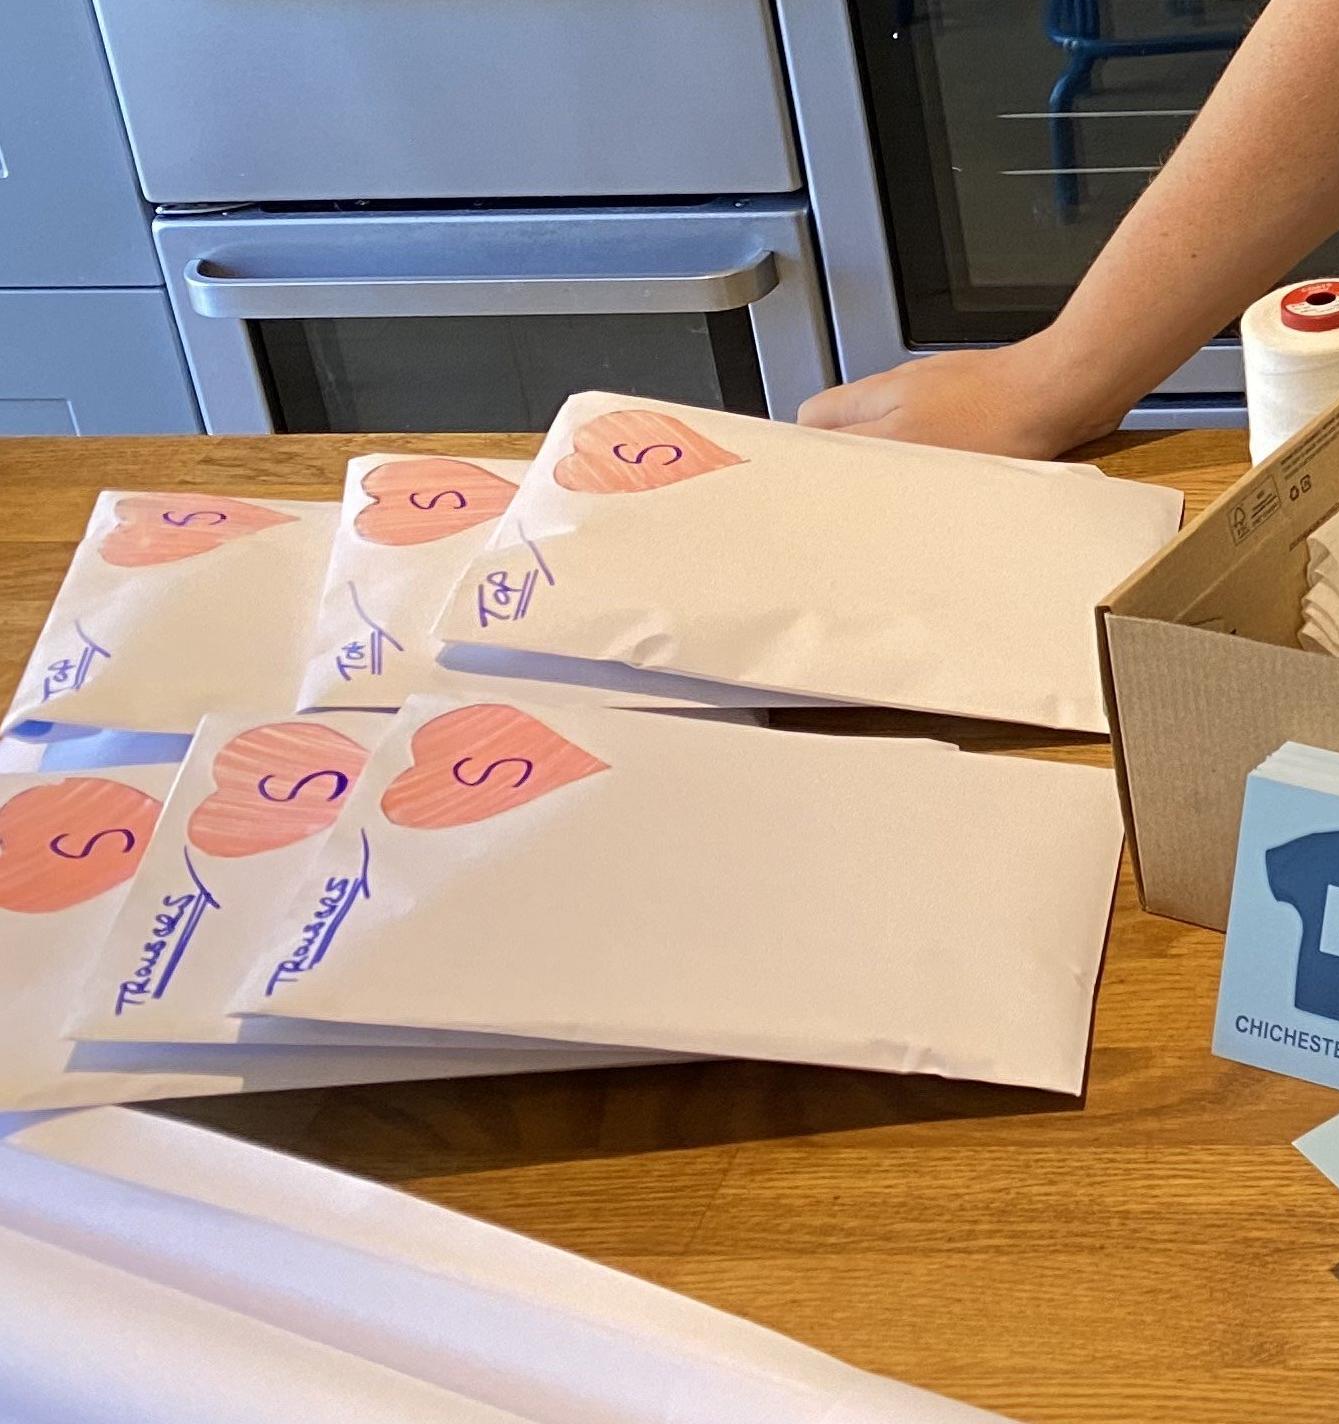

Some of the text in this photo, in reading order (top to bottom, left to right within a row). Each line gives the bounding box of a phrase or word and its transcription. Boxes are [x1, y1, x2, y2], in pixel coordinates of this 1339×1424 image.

[258, 769, 349, 802] S
[453, 756, 533, 788] S
[50, 828, 135, 861] S
